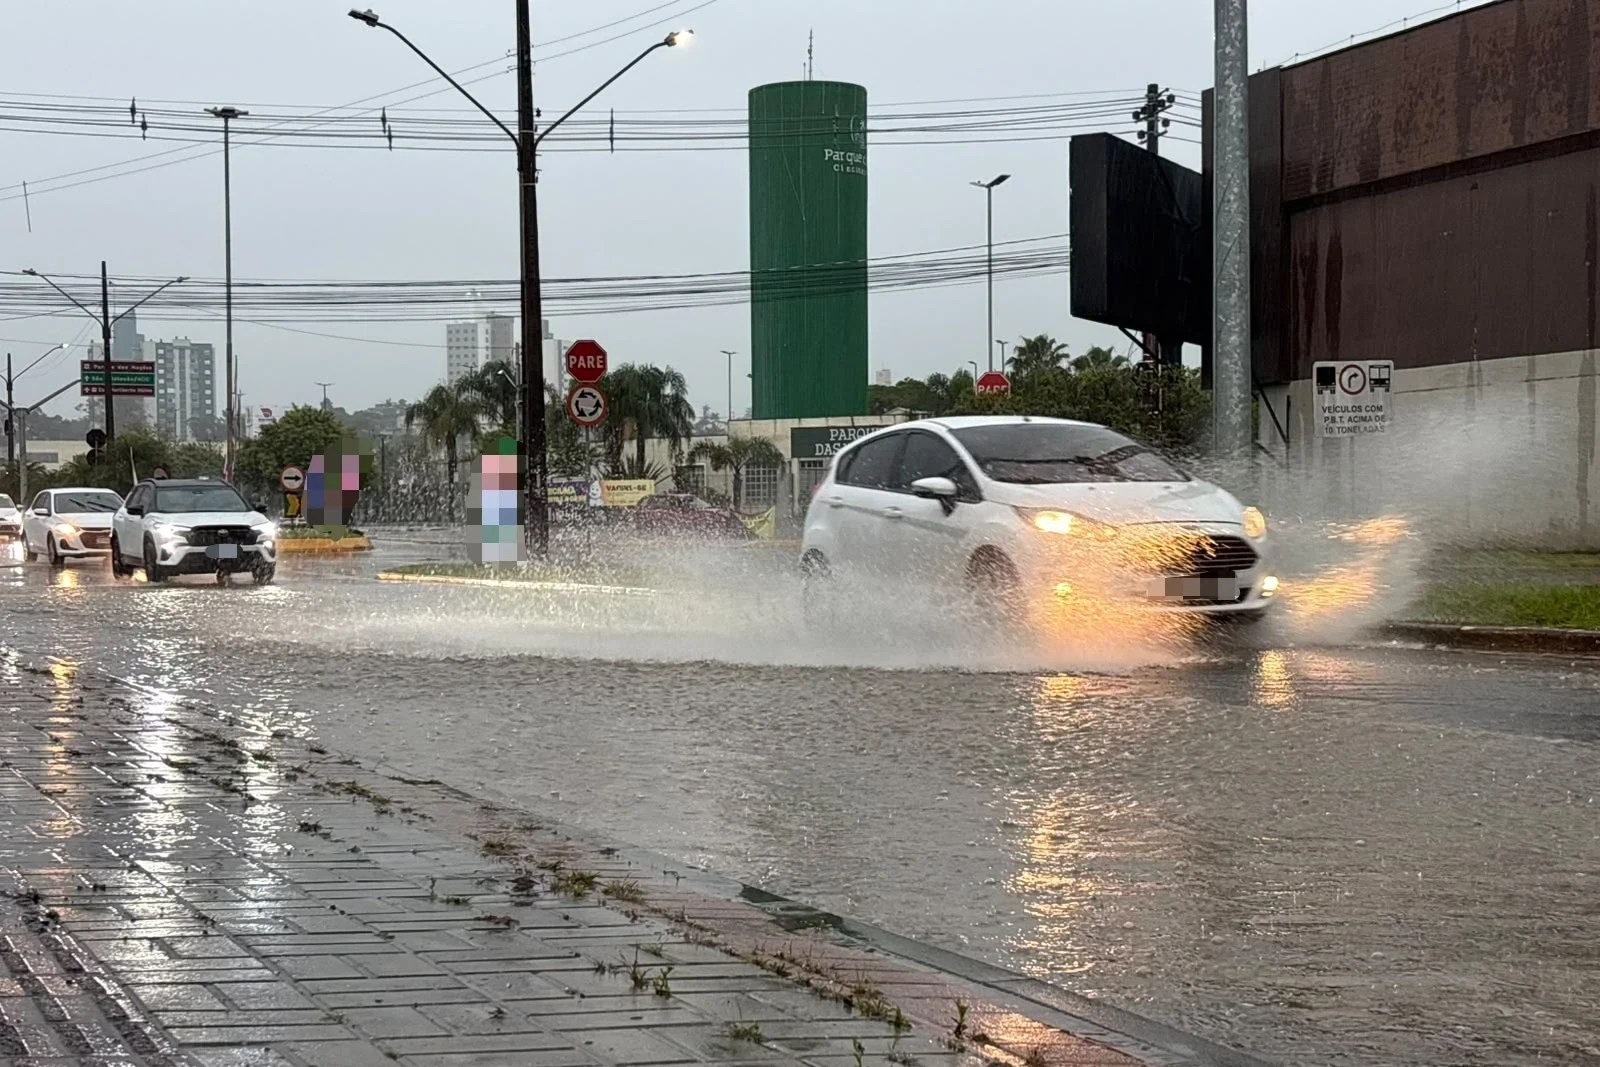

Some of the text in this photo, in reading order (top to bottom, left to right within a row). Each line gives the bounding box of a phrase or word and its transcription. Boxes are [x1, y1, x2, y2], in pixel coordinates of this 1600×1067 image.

[569, 355, 604, 369] PARE
[1321, 404, 1383, 413] VEÍCULOS COM
[1323, 416, 1345, 424] P.B.T.
[1347, 415, 1373, 423] ACIMA
[1325, 425, 1385, 434] 10 TONELADAS
[829, 428, 879, 441] PARQ
